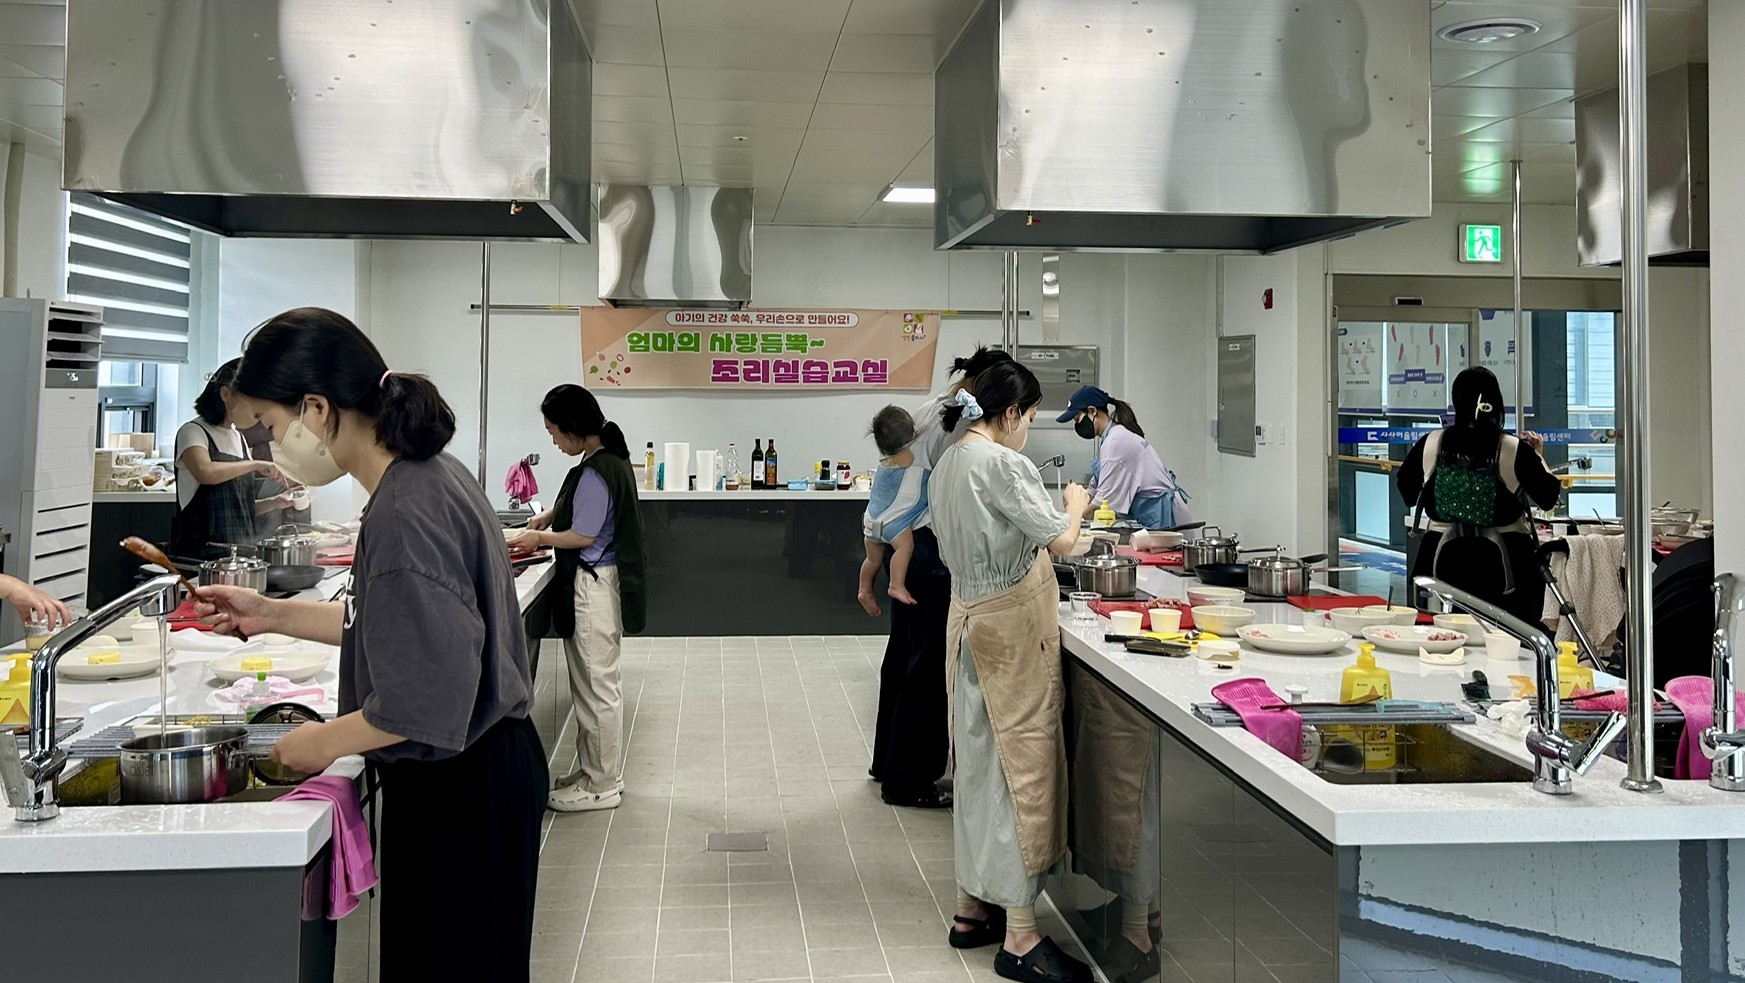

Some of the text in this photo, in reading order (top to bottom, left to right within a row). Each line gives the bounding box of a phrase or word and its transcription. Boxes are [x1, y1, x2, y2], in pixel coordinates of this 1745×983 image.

[675, 313, 850, 325] 아기의 건강 쑥쑥, 우리손으로 만들어요!
[626, 332, 825, 354] 엄마의 사랑듬뿍~
[710, 359, 888, 384] 조리실습교실
